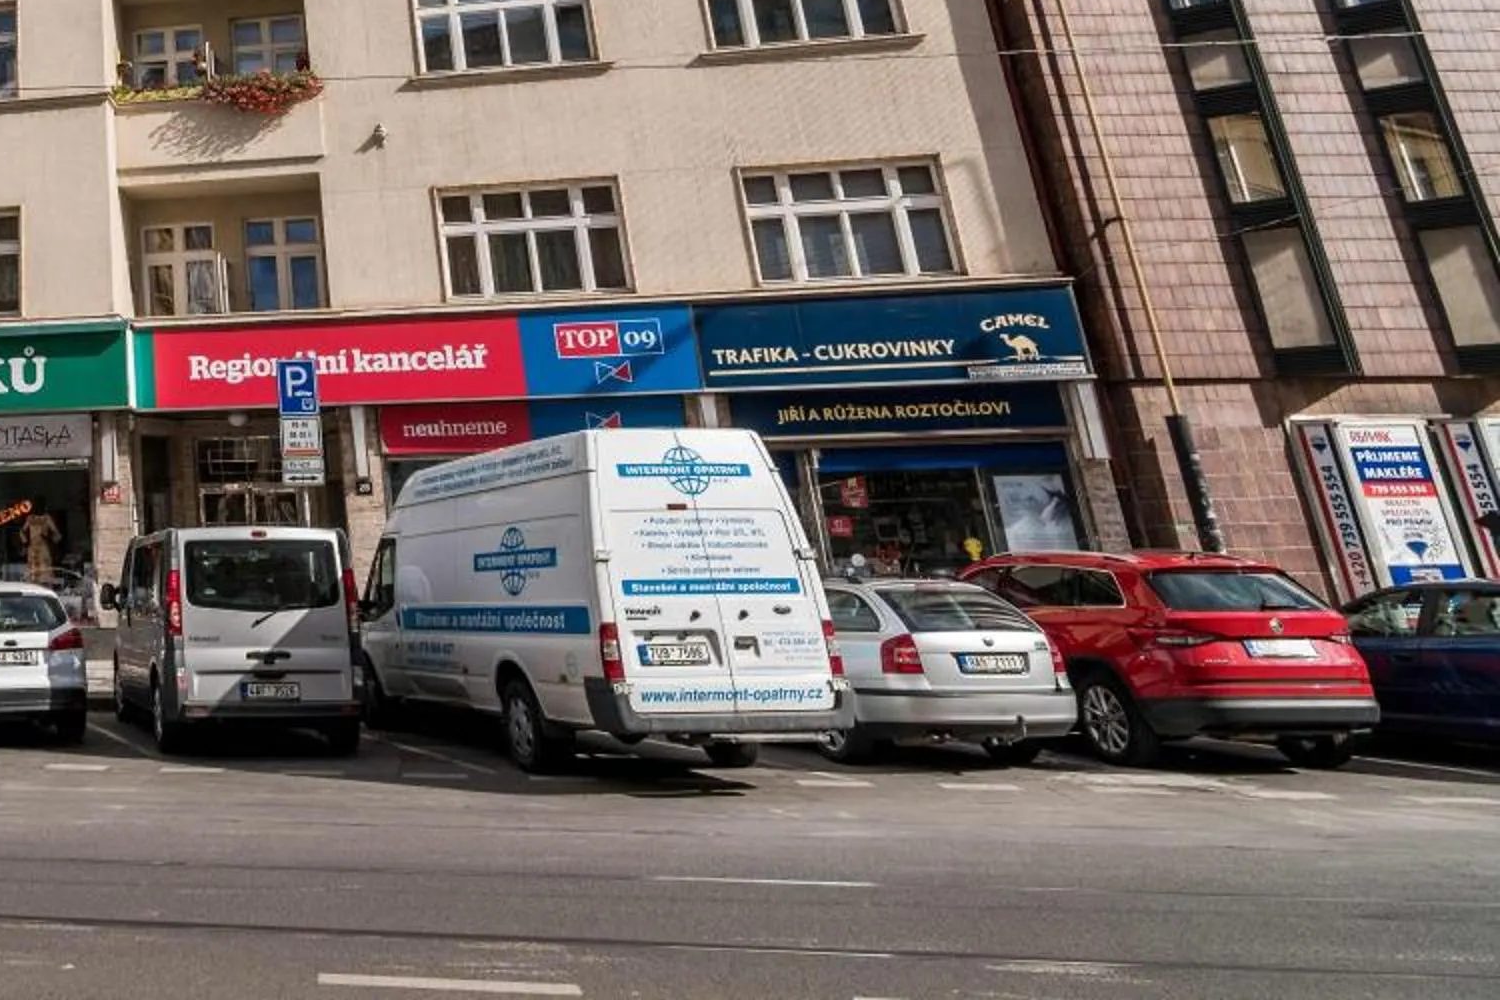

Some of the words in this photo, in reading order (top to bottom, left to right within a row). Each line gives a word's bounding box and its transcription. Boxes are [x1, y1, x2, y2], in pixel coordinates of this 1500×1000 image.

[980, 313, 1050, 332] CAMEL
[559, 328, 614, 349] TOP
[622, 328, 657, 348] 09
[187, 347, 349, 384] Regioní
[352, 342, 488, 373] kancelář
[711, 346, 798, 366] TRAFIKA
[814, 339, 955, 361] CUKROVINKY
[285, 366, 308, 398] P
[777, 405, 805, 424] JIŘÍ
[808, 407, 821, 422] A
[822, 401, 892, 422] RŮŽENA
[894, 399, 1012, 420] ROZTOČILOVI
[403, 418, 508, 437] neuhneme
[1320, 465, 1340, 491] 554
[1465, 463, 1487, 489] 554
[1329, 493, 1348, 522] 555
[1340, 523, 1357, 551] 739
[1348, 552, 1371, 587] +420
[738, 582, 791, 593] společnost
[503, 611, 566, 630] společnost
[640, 687, 823, 705] www.intermont-opatrny.cz
